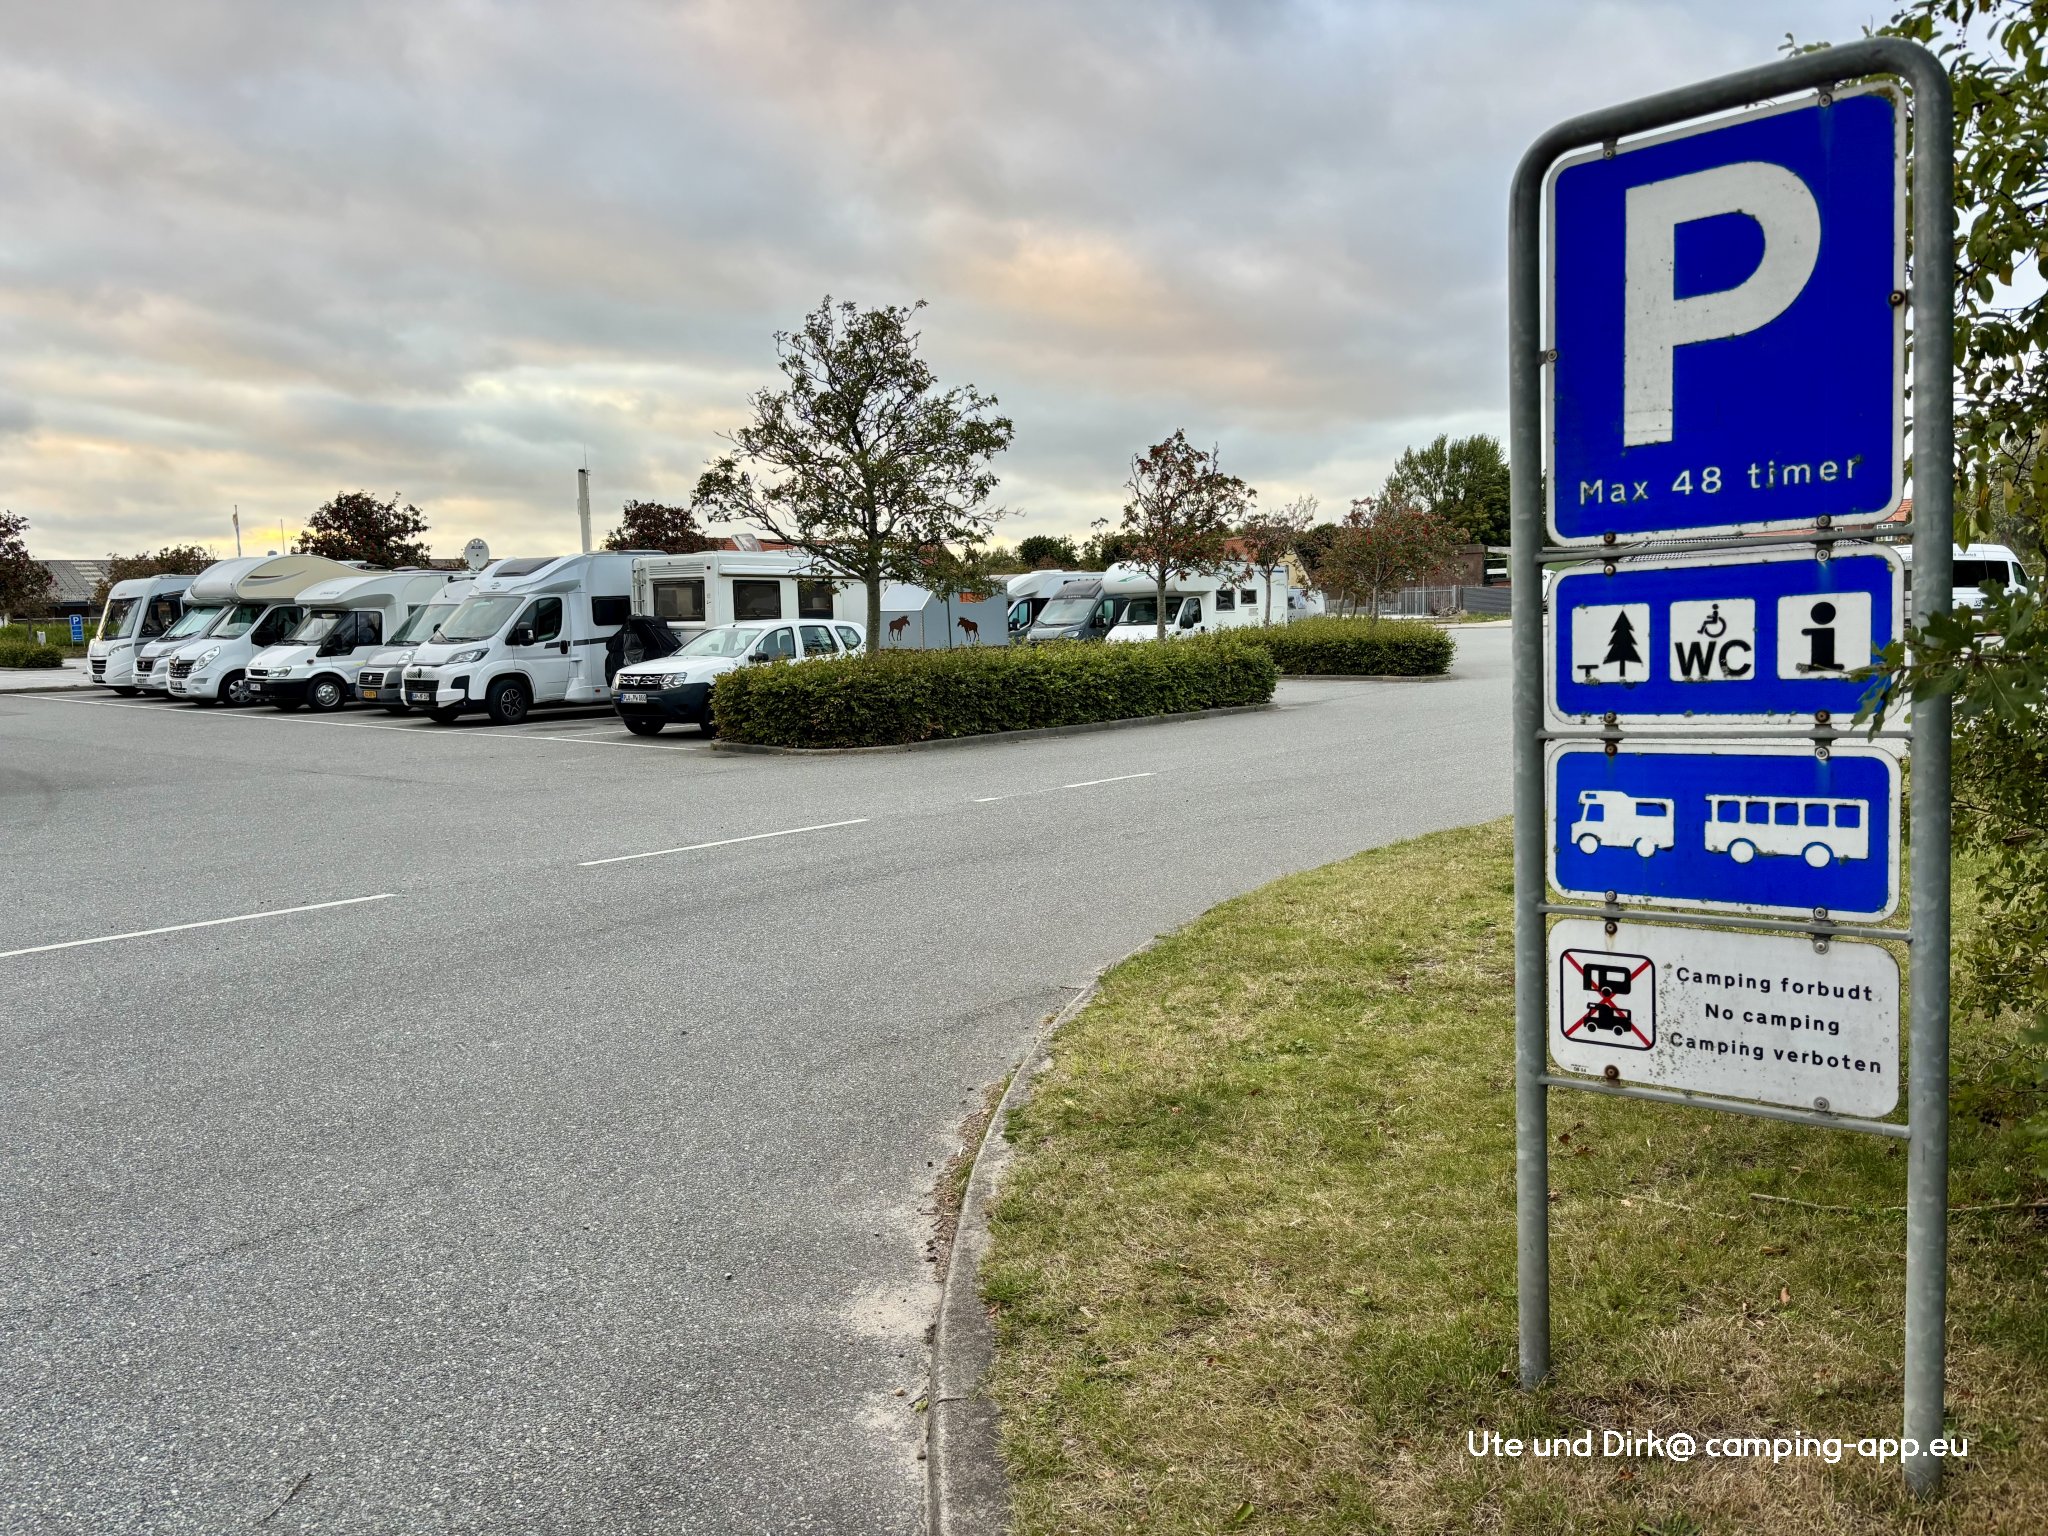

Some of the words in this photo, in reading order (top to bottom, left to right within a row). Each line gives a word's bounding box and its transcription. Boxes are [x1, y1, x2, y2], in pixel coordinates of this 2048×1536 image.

[1624, 161, 1821, 447] P
[1579, 479, 1649, 505] Max
[1672, 467, 1722, 495] 48
[1748, 455, 1862, 489] timer
[1675, 639, 1752, 677] WC
[1676, 966, 1772, 994] Camping
[1780, 977, 1874, 1002] forbudt
[1705, 1004, 1734, 1020] No
[1742, 1010, 1840, 1036] camping
[1670, 1032, 1764, 1061] Camping
[1773, 1047, 1882, 1074] verboten
